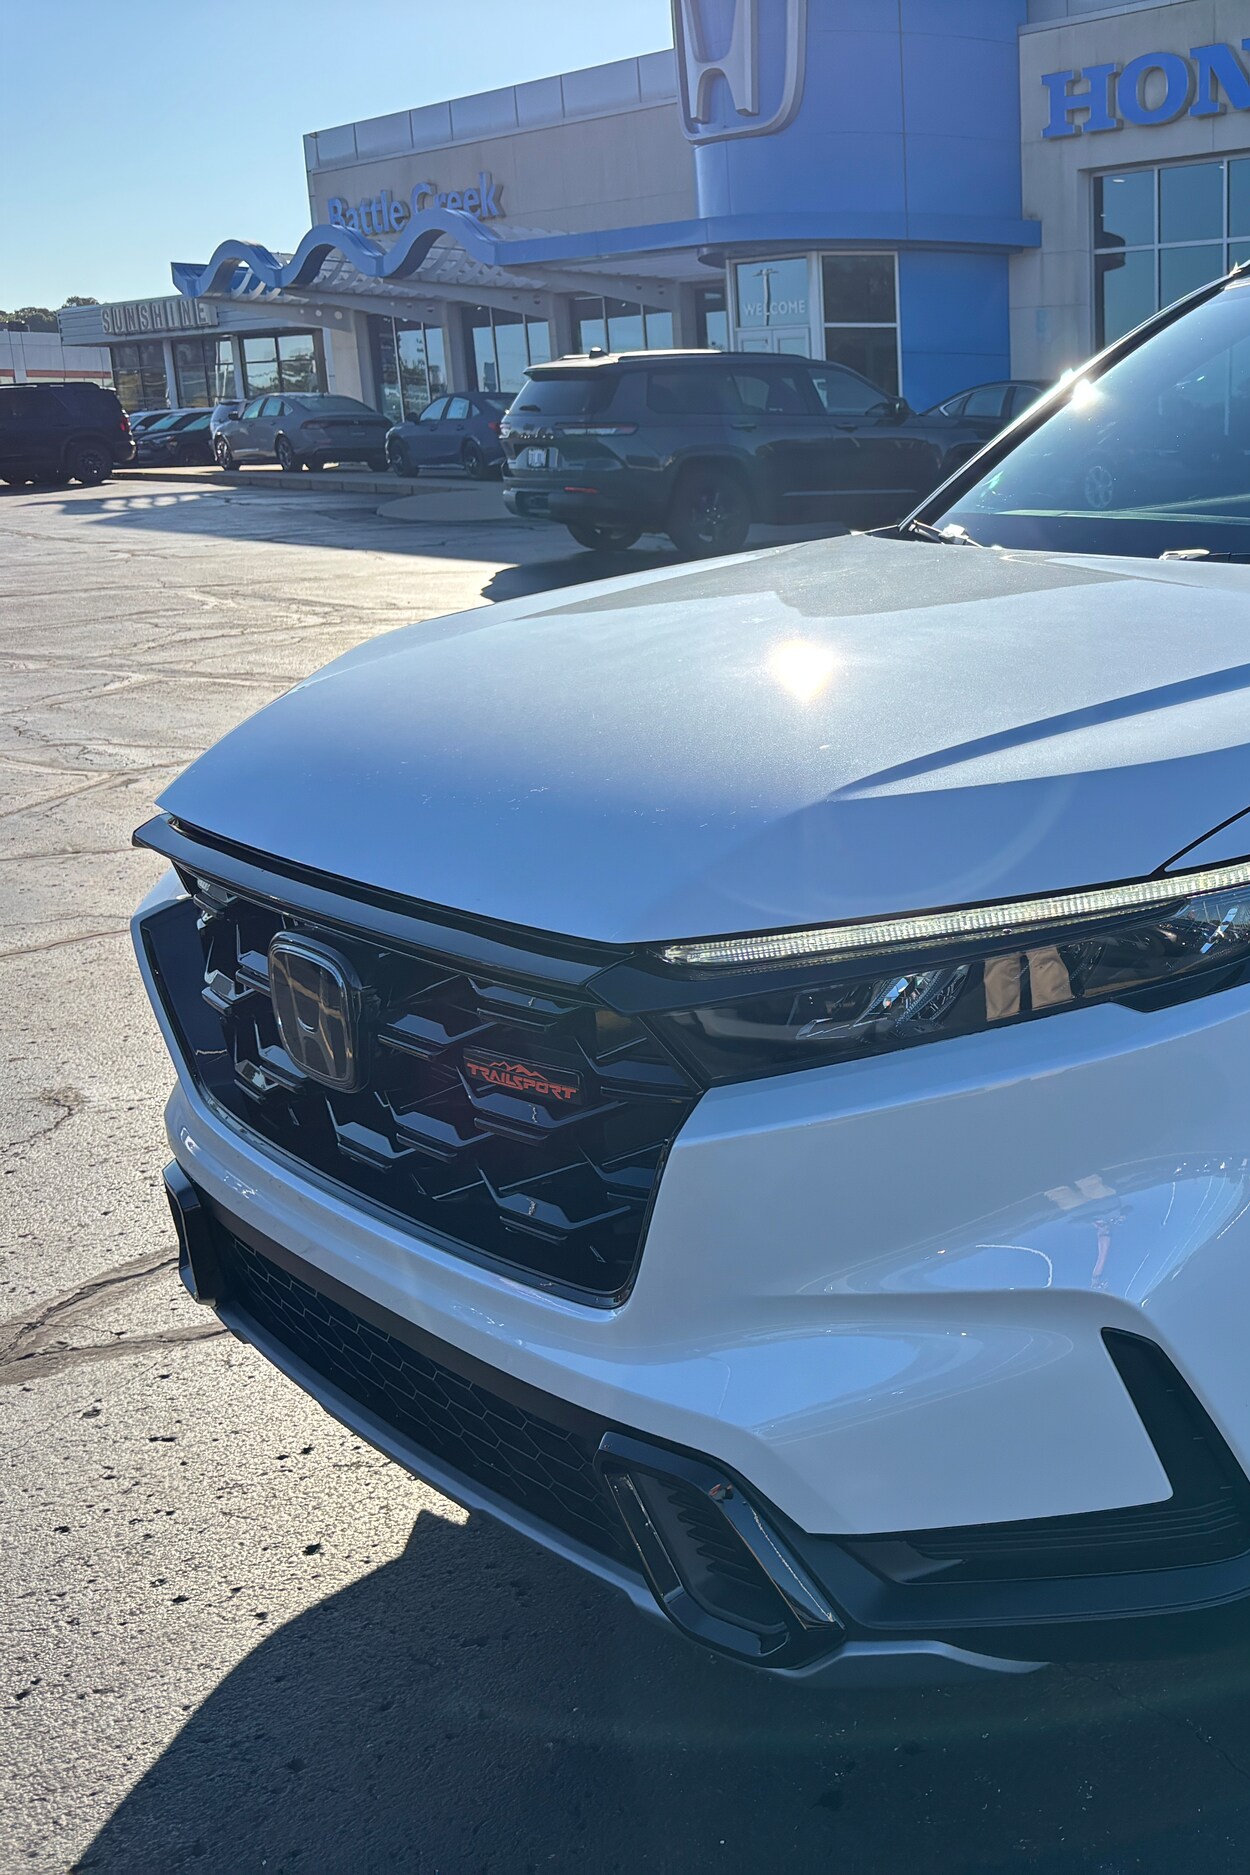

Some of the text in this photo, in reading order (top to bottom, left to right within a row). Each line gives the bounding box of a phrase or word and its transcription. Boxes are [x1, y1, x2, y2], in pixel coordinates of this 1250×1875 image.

[327, 171, 504, 235] Battle Creek
[102, 299, 210, 334] SUNSHINE
[467, 1062, 577, 1100] TRAILSPORT
